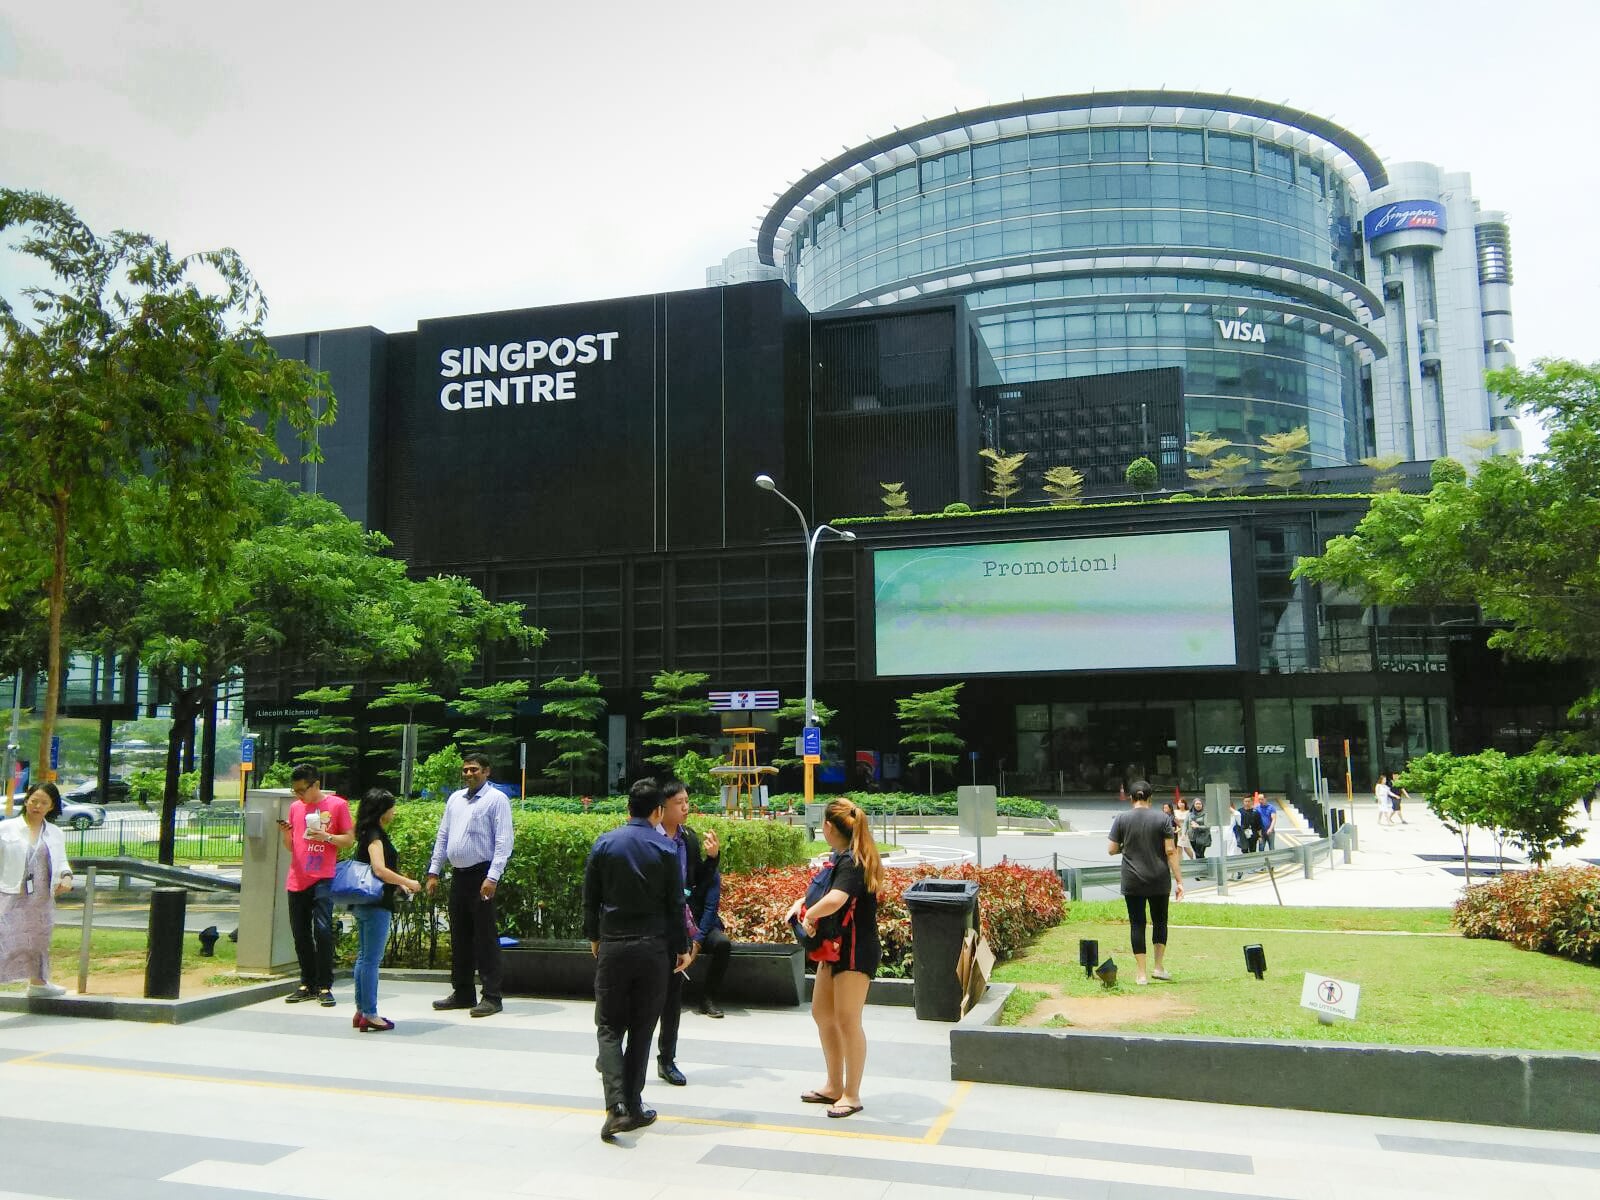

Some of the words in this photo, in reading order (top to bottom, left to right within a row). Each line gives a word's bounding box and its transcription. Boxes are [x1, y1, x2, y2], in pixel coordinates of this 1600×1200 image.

[1375, 206, 1438, 231] Singapore
[1215, 319, 1266, 343] VISA
[440, 331, 619, 378] SINGPOST
[440, 371, 577, 412] CENTRE
[983, 553, 1117, 577] Promotion!
[1319, 1003, 1346, 1015] LITTERING
